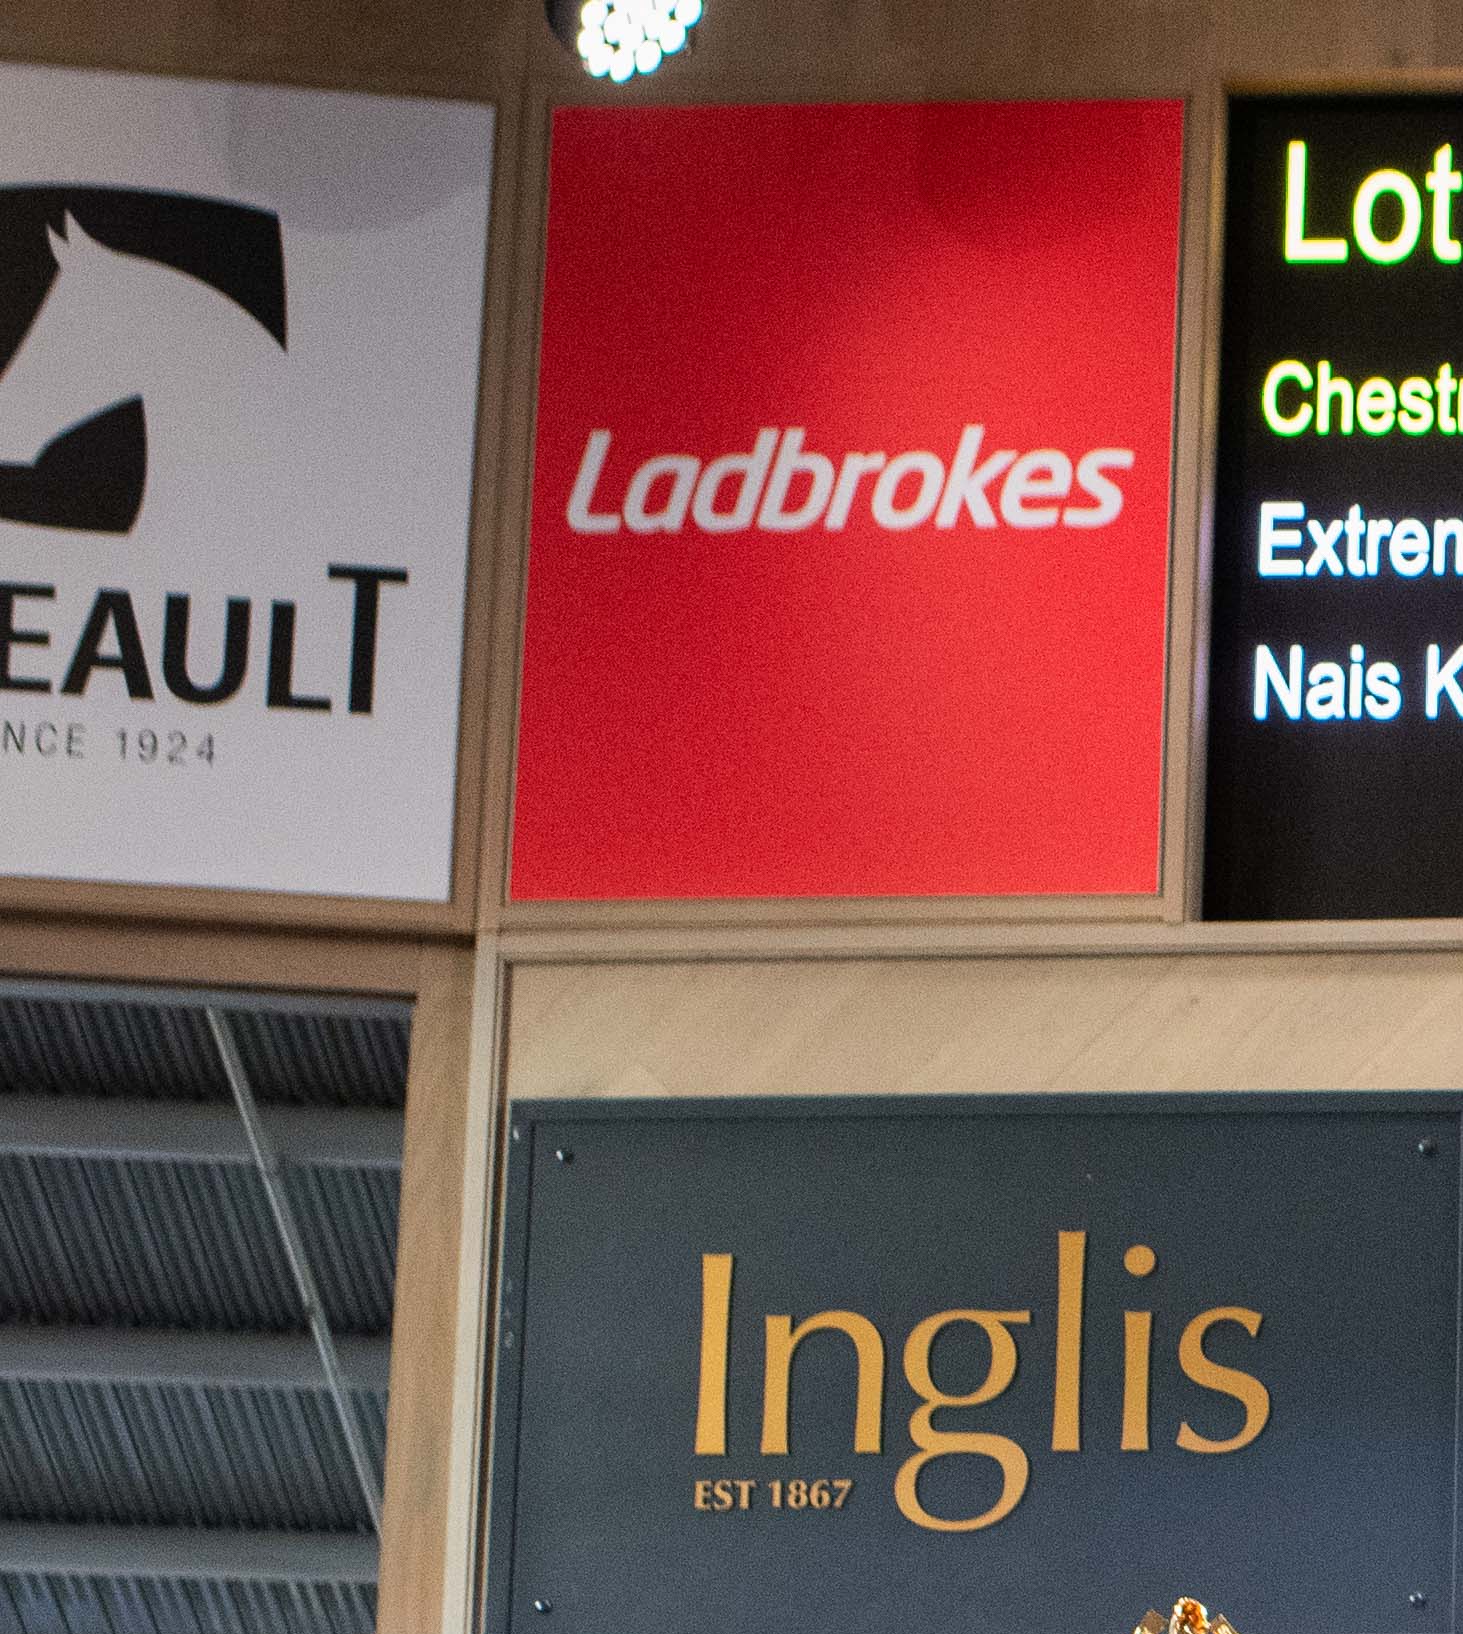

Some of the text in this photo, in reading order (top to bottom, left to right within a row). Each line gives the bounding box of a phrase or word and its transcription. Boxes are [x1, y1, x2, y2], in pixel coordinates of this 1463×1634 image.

[1282, 138, 1463, 265] Lot
[566, 422, 1137, 534] Ladbrokes
[1251, 642, 1404, 722] Nais
[114, 727, 217, 767] 1924
[692, 1229, 1273, 1534] Inglis
[693, 1480, 852, 1511] EST 1867
